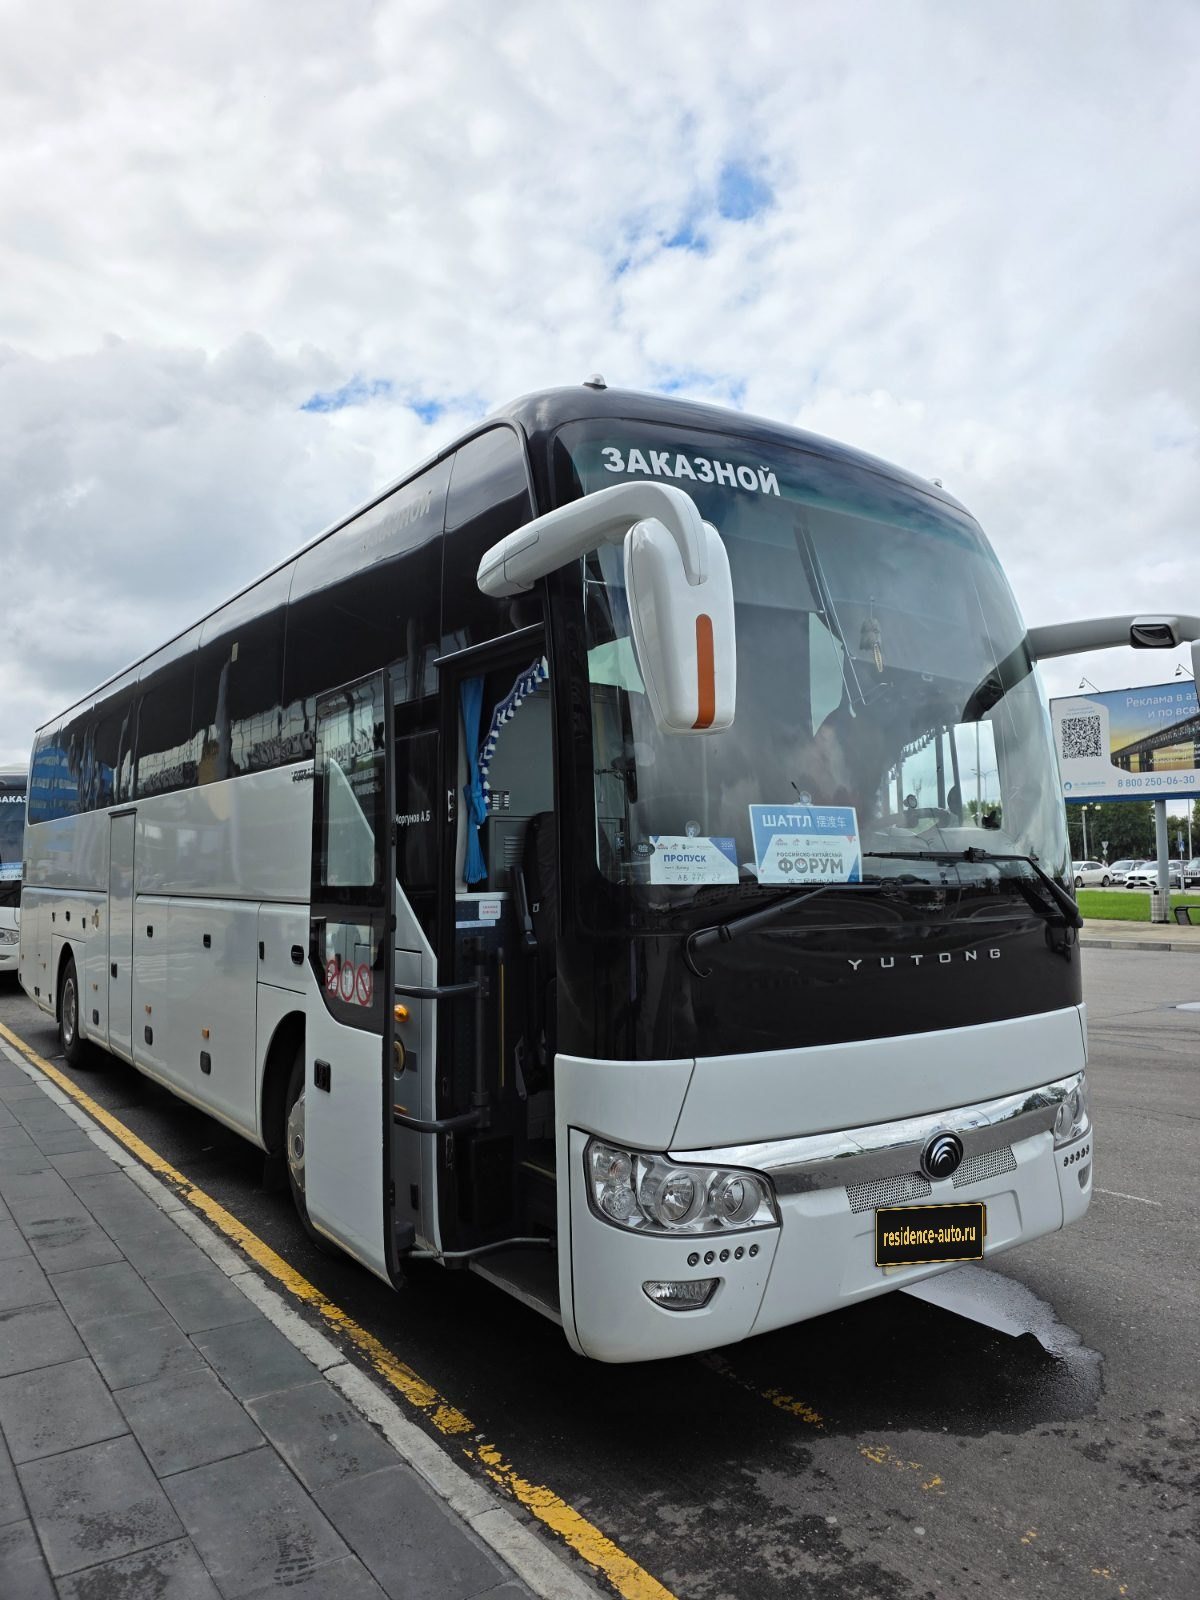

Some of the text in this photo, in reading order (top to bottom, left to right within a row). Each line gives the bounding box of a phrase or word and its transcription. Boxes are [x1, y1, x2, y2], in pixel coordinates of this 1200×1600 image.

[601, 446, 781, 497] ЗАКАЗНОЙ
[1126, 694, 1173, 708] Реклама
[1176, 694, 1183, 702] в
[1147, 711, 1155, 719] и
[1158, 709, 1173, 717] по
[1117, 775, 1195, 788] 8 800 250-06-30
[762, 814, 812, 828] ШАТТЛ
[663, 854, 707, 863] ПРОПУСК
[778, 857, 844, 874] ФОРУМ
[848, 947, 1001, 971] YUTONG
